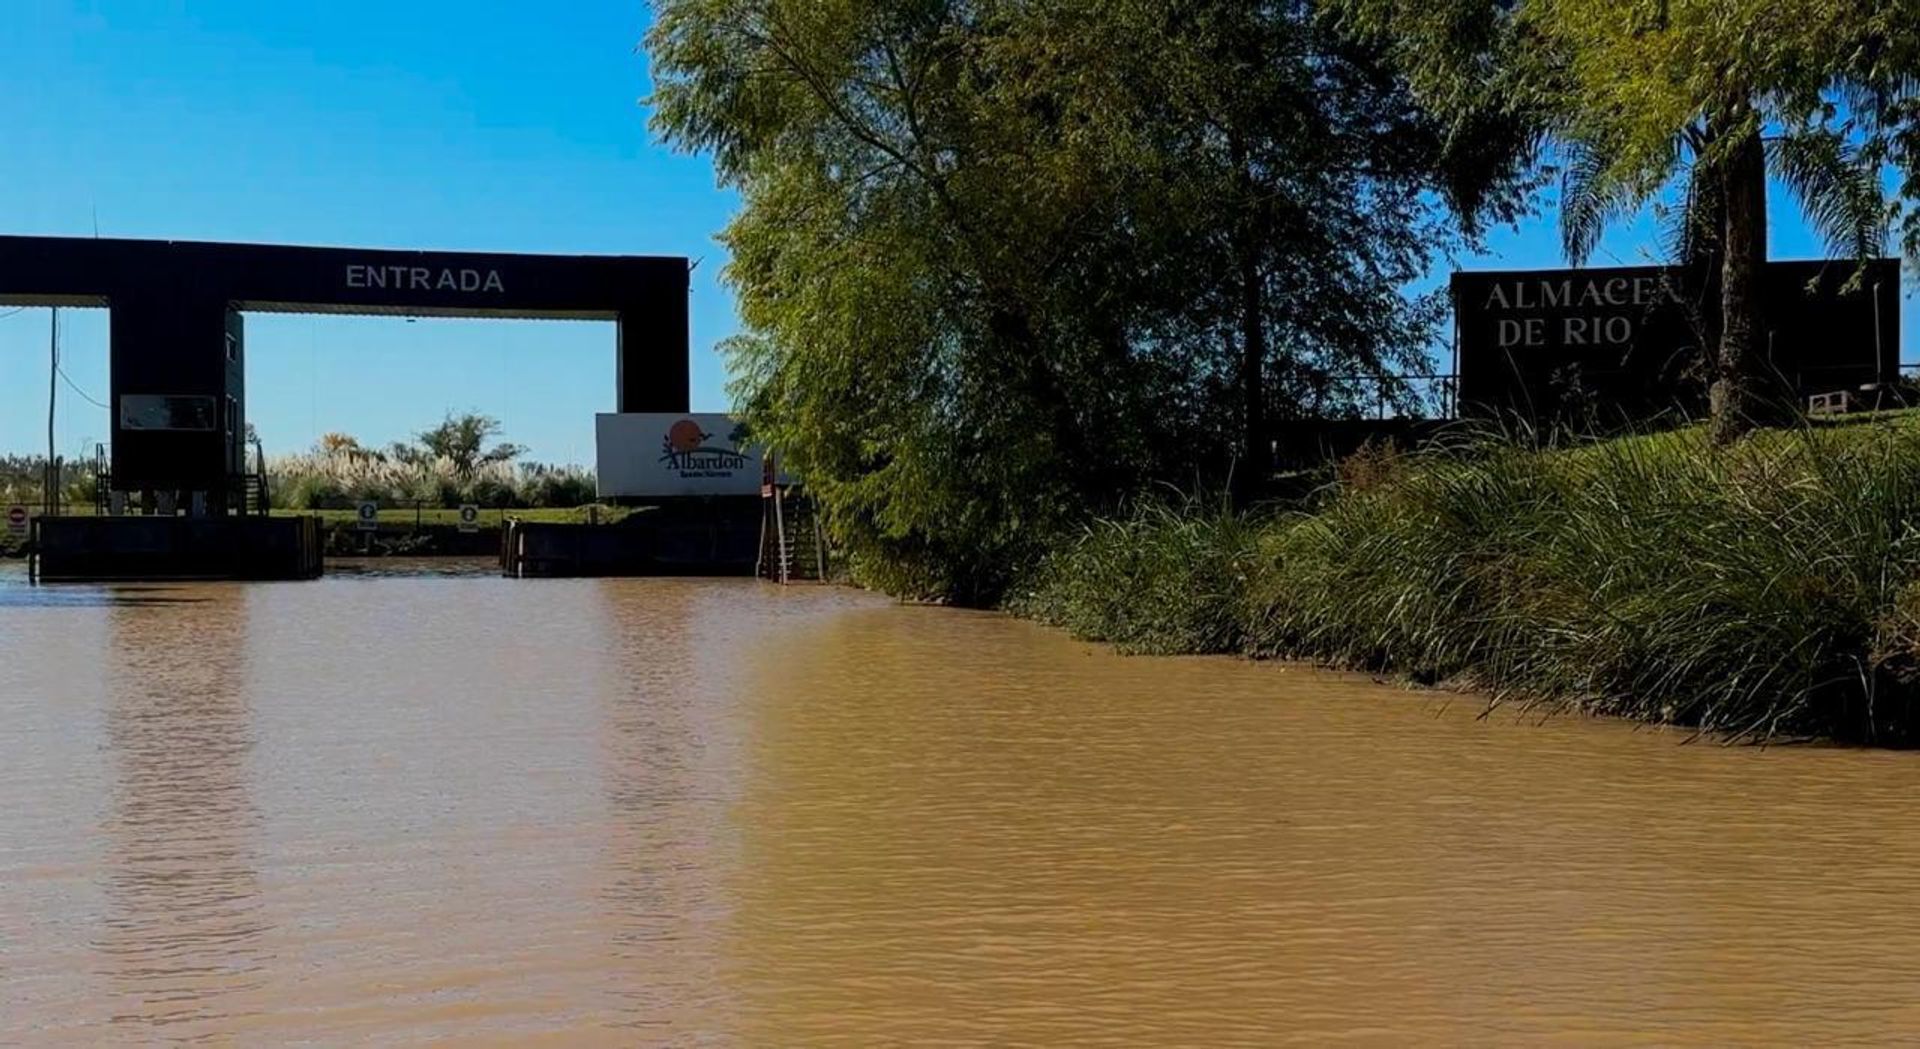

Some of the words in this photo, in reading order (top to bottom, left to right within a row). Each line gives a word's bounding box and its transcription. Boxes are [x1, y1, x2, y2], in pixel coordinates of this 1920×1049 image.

[346, 264, 505, 293] ENTRADA
[1499, 318, 1545, 347] DE
[1563, 316, 1632, 345] RIO
